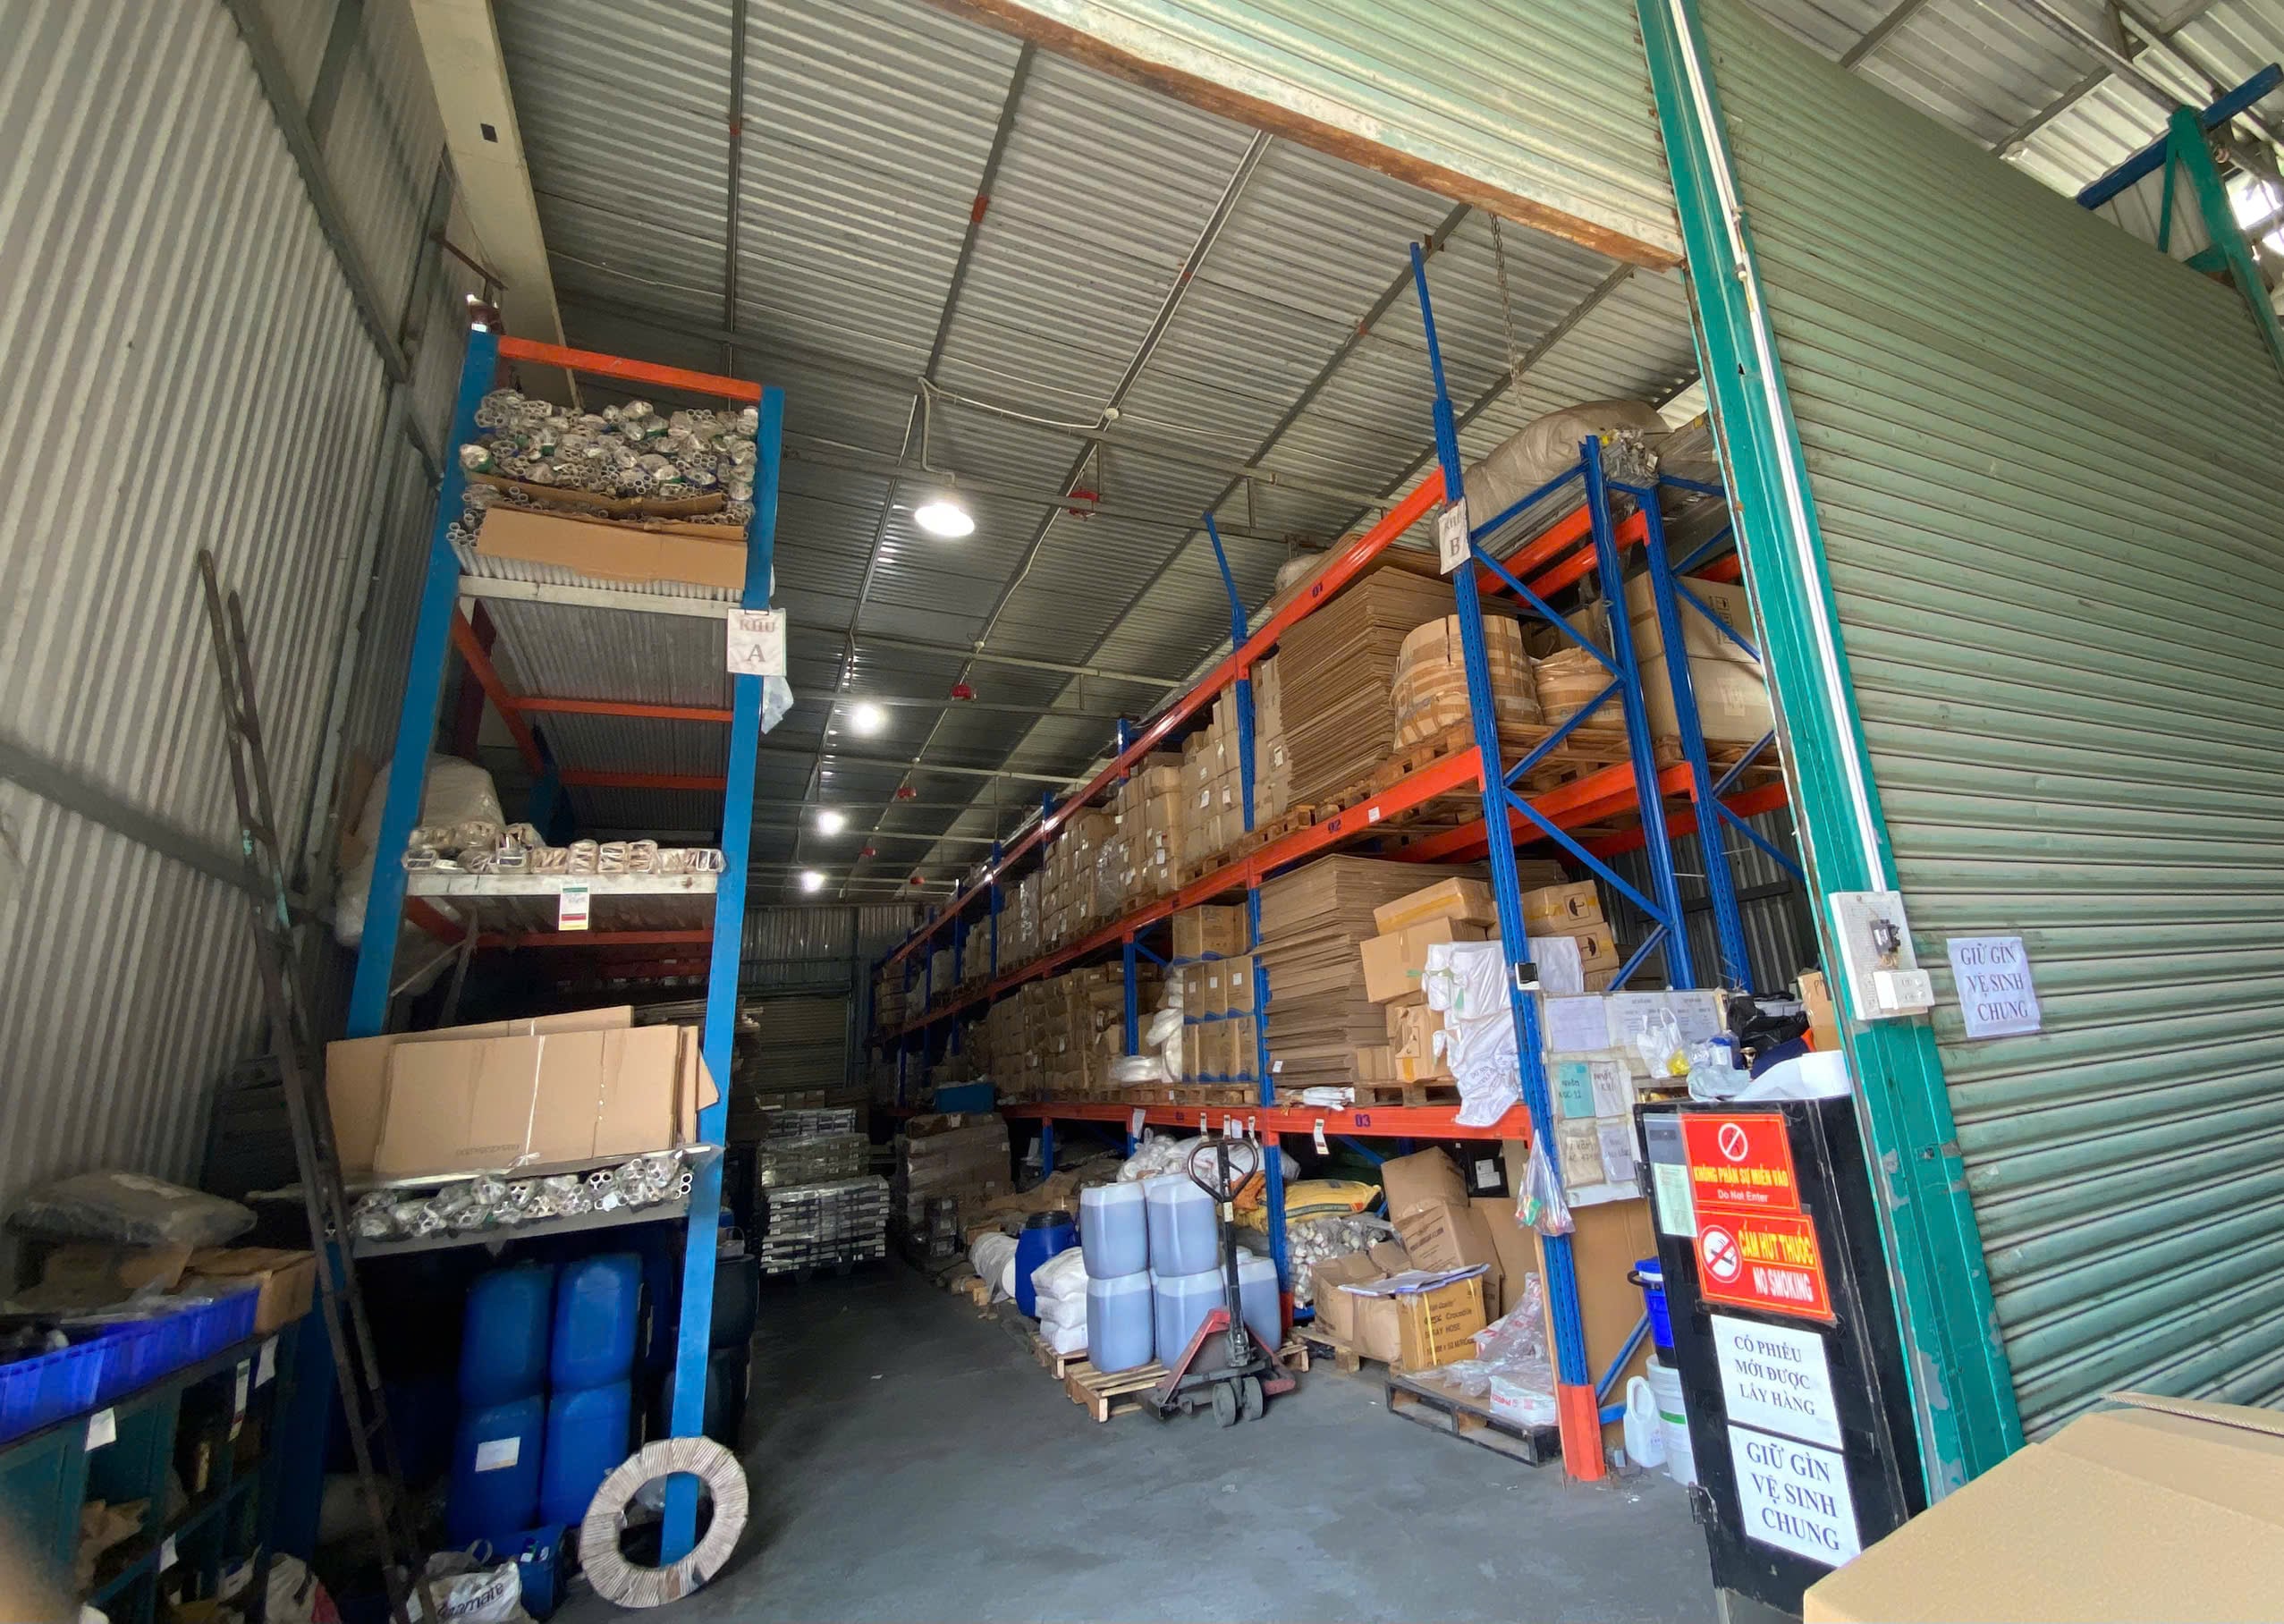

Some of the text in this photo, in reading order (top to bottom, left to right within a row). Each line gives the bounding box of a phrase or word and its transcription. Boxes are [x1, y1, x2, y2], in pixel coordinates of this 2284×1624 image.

[1451, 537, 1460, 556] B
[748, 644, 766, 662] A
[1328, 819, 1341, 833] 02
[1960, 943, 2017, 965] GIỮ GÌN
[1966, 972, 2025, 997] VỆ SINH
[1977, 1000, 2028, 1021] CHUNG
[1355, 1113, 1371, 1127] 03
[1718, 1188, 1769, 1203] Do Not Enter
[1759, 1224, 1779, 1260] HÚT
[1753, 1266, 1814, 1302] NO SMOKING
[1734, 1334, 1755, 1352] CÓ
[1735, 1358, 1811, 1391] MỚI ĐƯỢC
[1772, 1390, 1815, 1415] HÀNG
[1747, 1441, 1831, 1484] GIỮ GÌN
[1750, 1473, 1839, 1518] VỆ SINH
[1762, 1507, 1840, 1551] CHUNG
